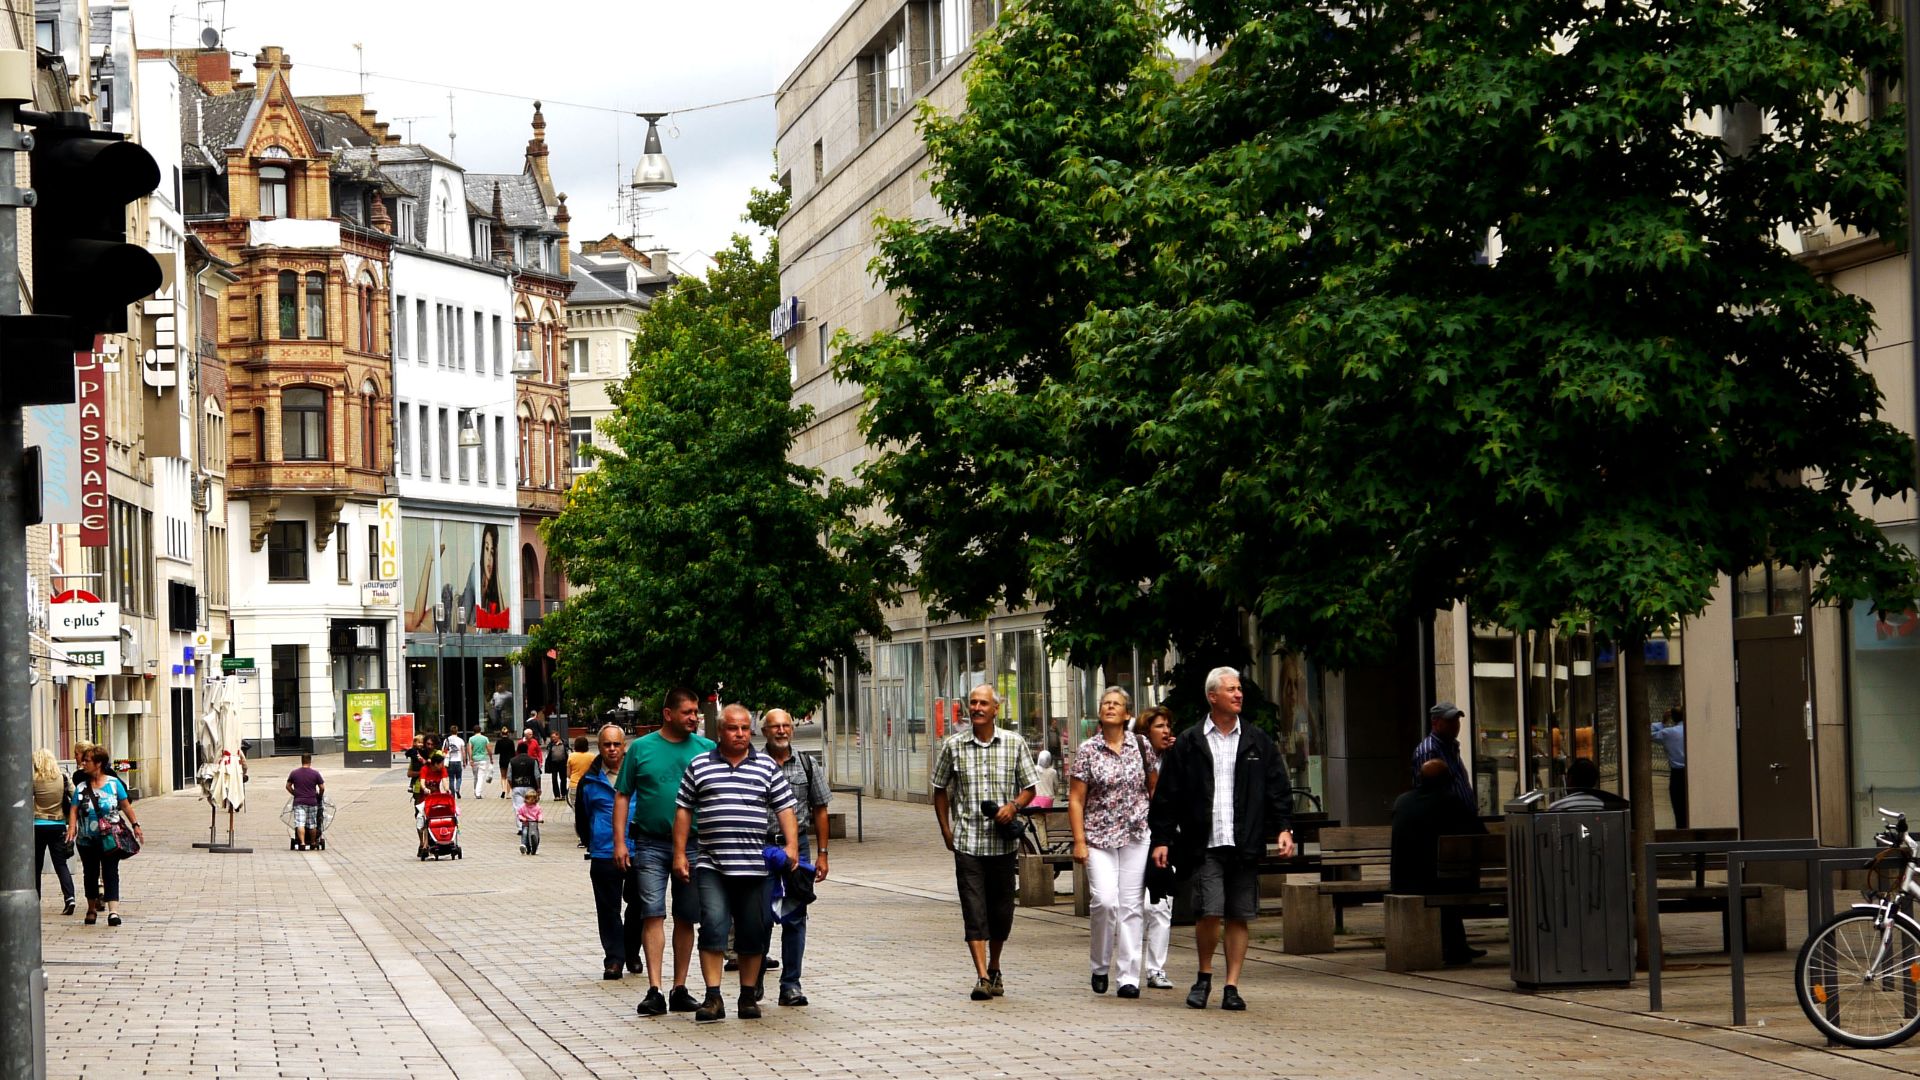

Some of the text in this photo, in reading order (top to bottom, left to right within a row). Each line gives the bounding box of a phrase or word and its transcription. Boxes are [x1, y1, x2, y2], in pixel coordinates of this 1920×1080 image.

[31, 405, 76, 509] Dougla
[81, 381, 105, 530] PASSAGE
[381, 502, 395, 577] KINO
[364, 581, 397, 589] HOLLYWOOD
